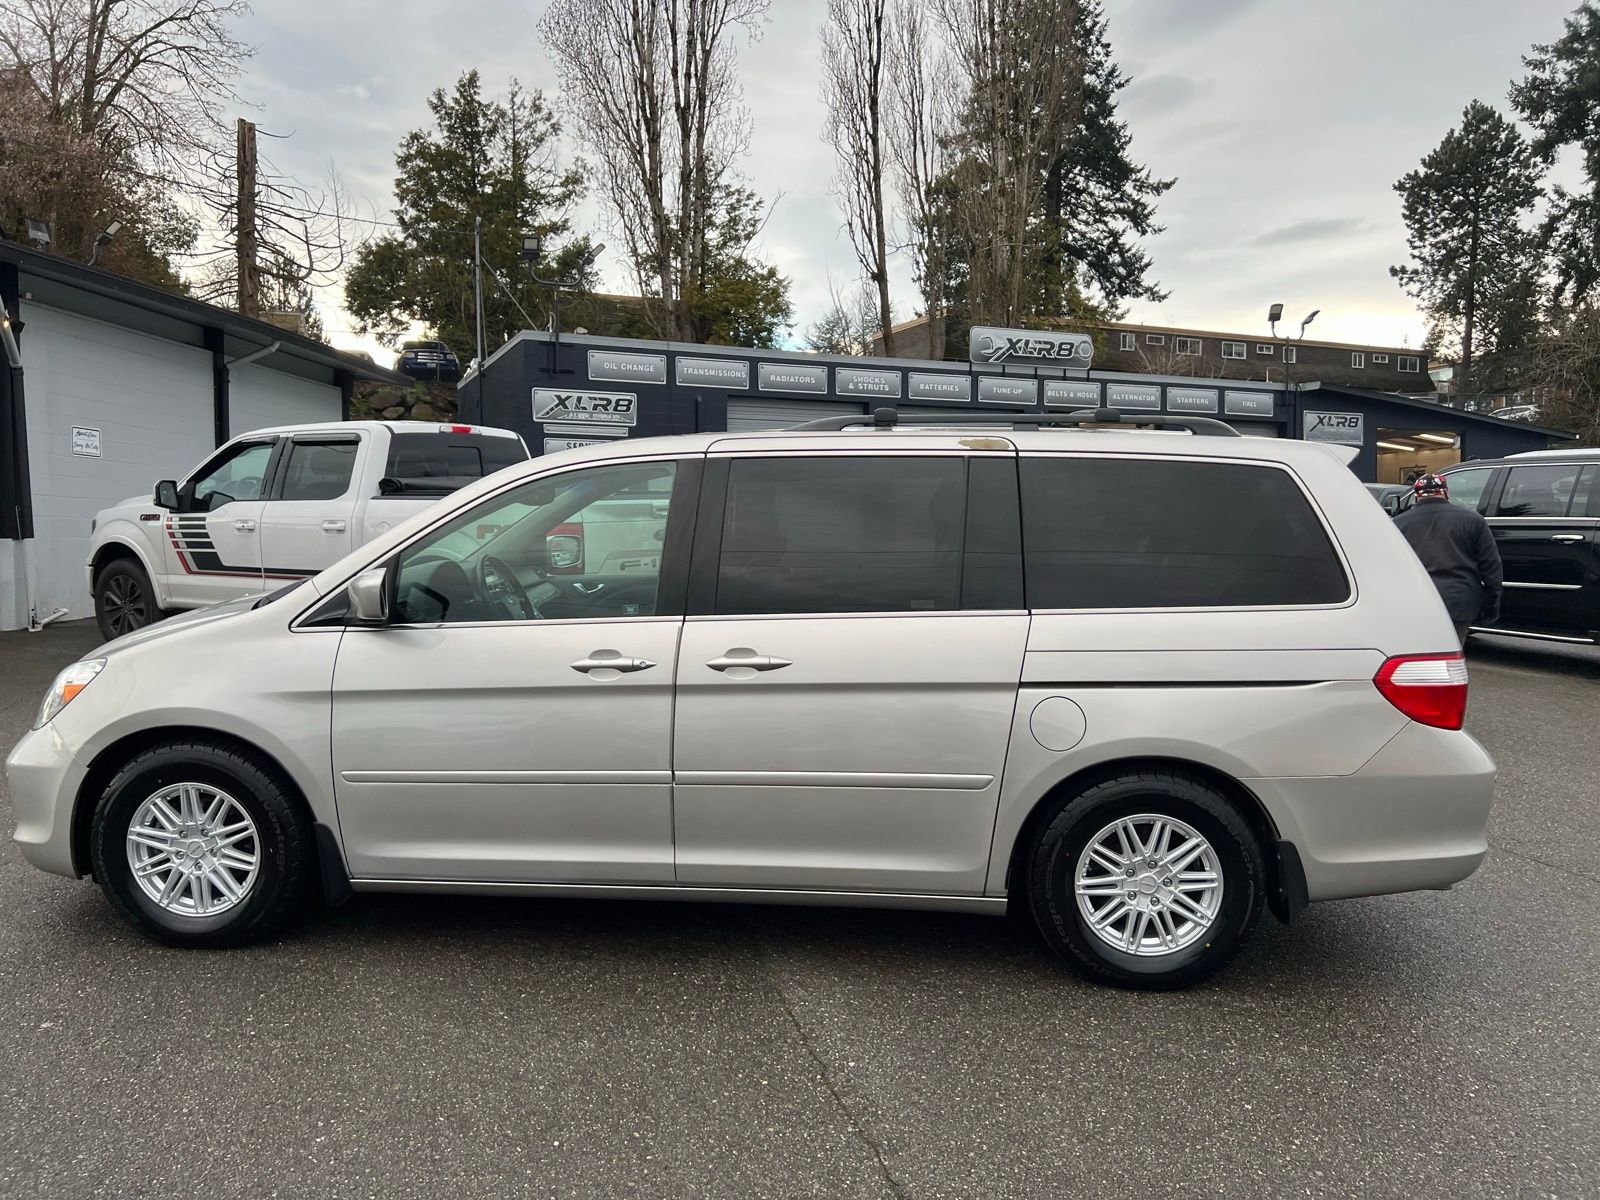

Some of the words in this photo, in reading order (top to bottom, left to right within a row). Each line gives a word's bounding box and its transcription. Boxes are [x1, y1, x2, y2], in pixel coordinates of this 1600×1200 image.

[990, 337, 1075, 363] XLR8
[603, 361, 618, 371] OIL
[620, 362, 655, 373] CHANGE
[682, 367, 746, 379] TRANSMISSIONS
[770, 374, 816, 384] RADIATORS
[852, 375, 885, 384] SHOCKS
[858, 383, 889, 391] STRUTS
[919, 383, 959, 392] BATTERIES
[992, 386, 1023, 395] TUNE-UP
[1047, 390, 1067, 398] BELTS
[1076, 391, 1098, 399] HOSES
[1112, 392, 1156, 402] ALTERNATOR
[1176, 396, 1209, 405] STARTERS
[1241, 400, 1257, 408] TIRES
[538, 394, 634, 417] XLR8
[1309, 415, 1360, 432] XLR8
